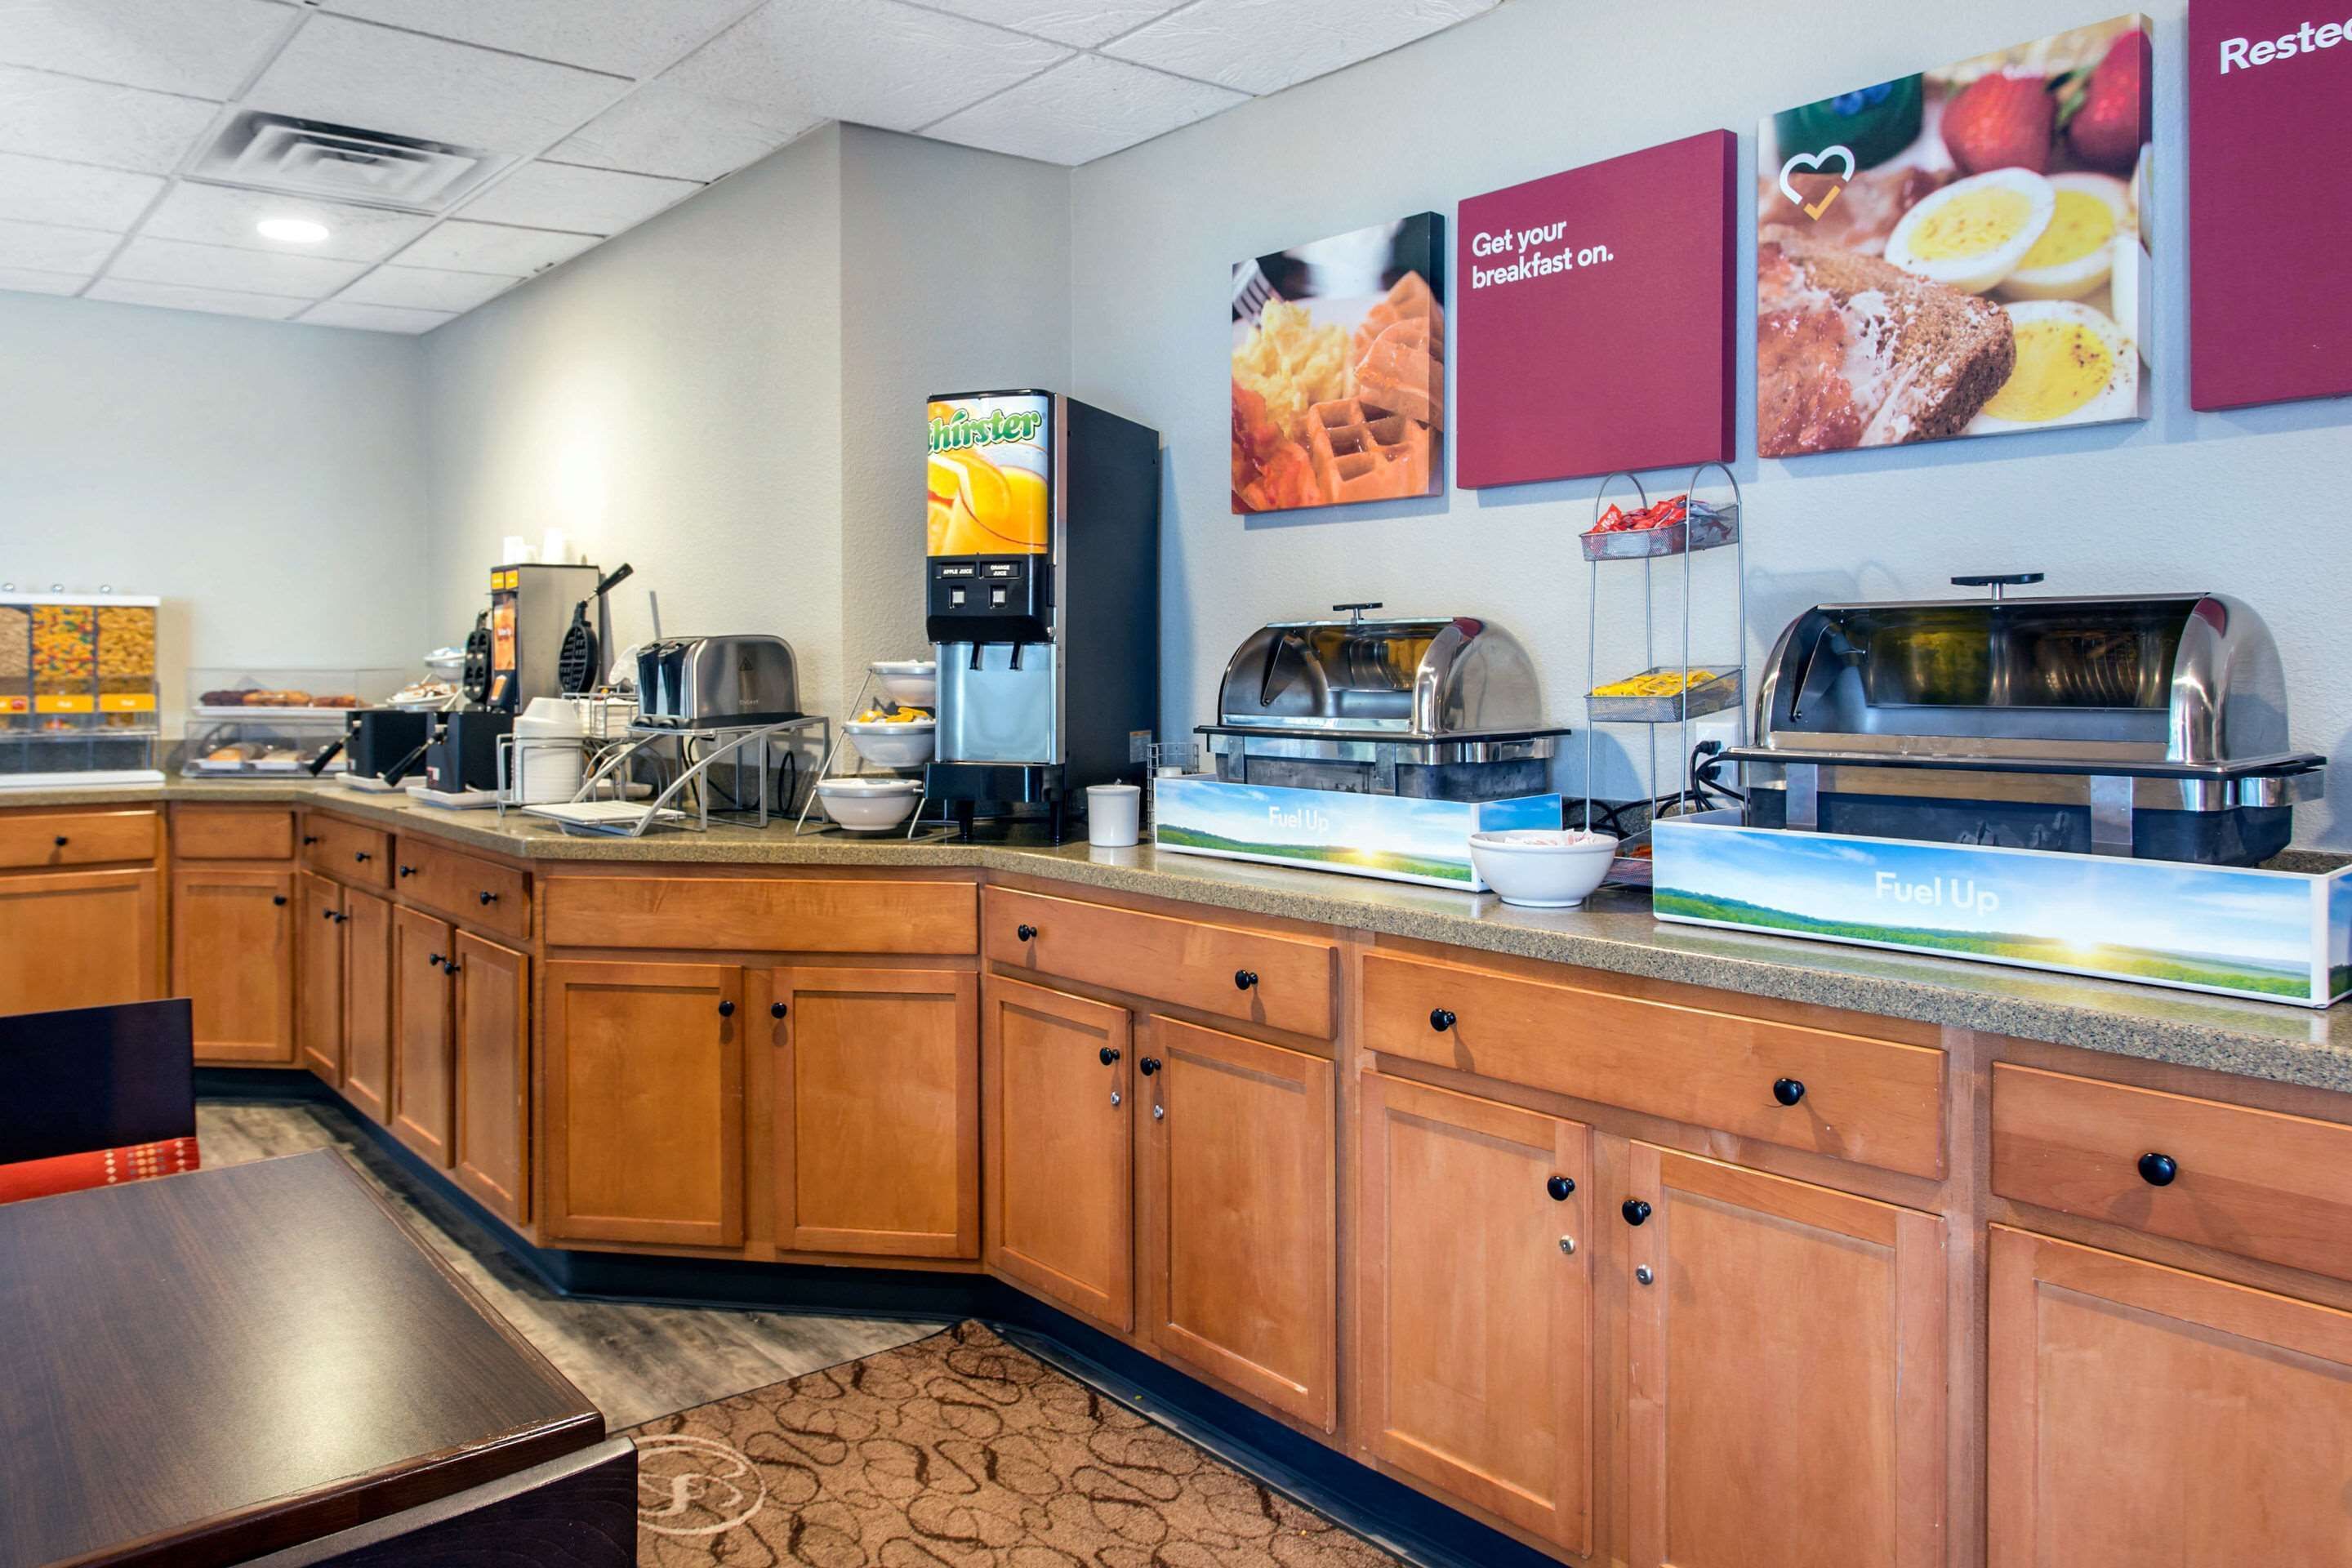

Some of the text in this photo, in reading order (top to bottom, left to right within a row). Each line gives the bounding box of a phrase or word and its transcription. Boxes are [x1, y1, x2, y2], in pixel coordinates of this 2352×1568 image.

[1472, 220, 1567, 257] Get your
[1472, 244, 1614, 289] breakfast on.
[1268, 806, 1330, 836] Fuel Up
[1876, 871, 2000, 917] Fuel Up
